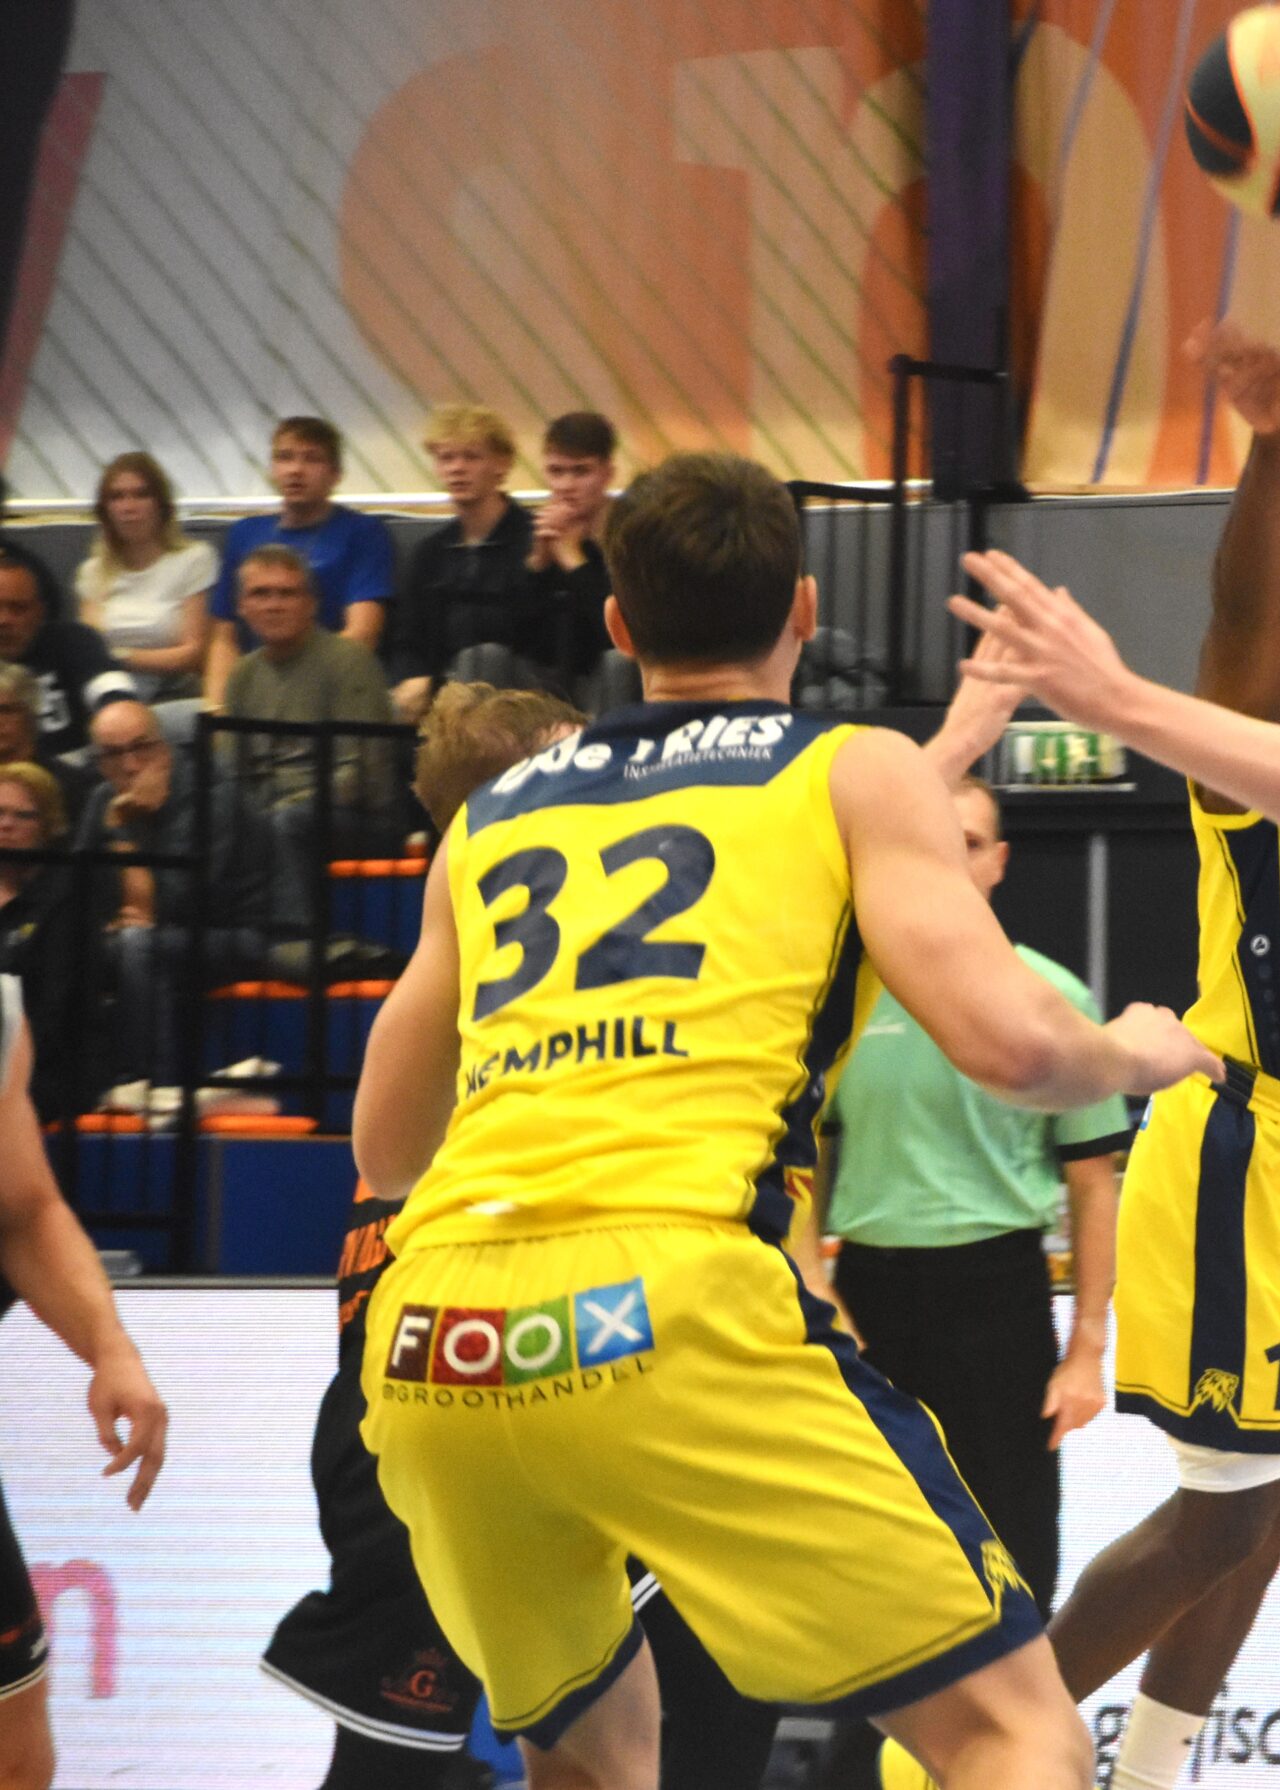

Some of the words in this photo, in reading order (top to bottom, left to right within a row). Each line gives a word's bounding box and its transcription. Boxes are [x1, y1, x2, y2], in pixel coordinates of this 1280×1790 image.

[472, 823, 716, 1023] 32
[465, 1015, 690, 1099] HEMPHILL
[390, 1290, 645, 1375] FOOX
